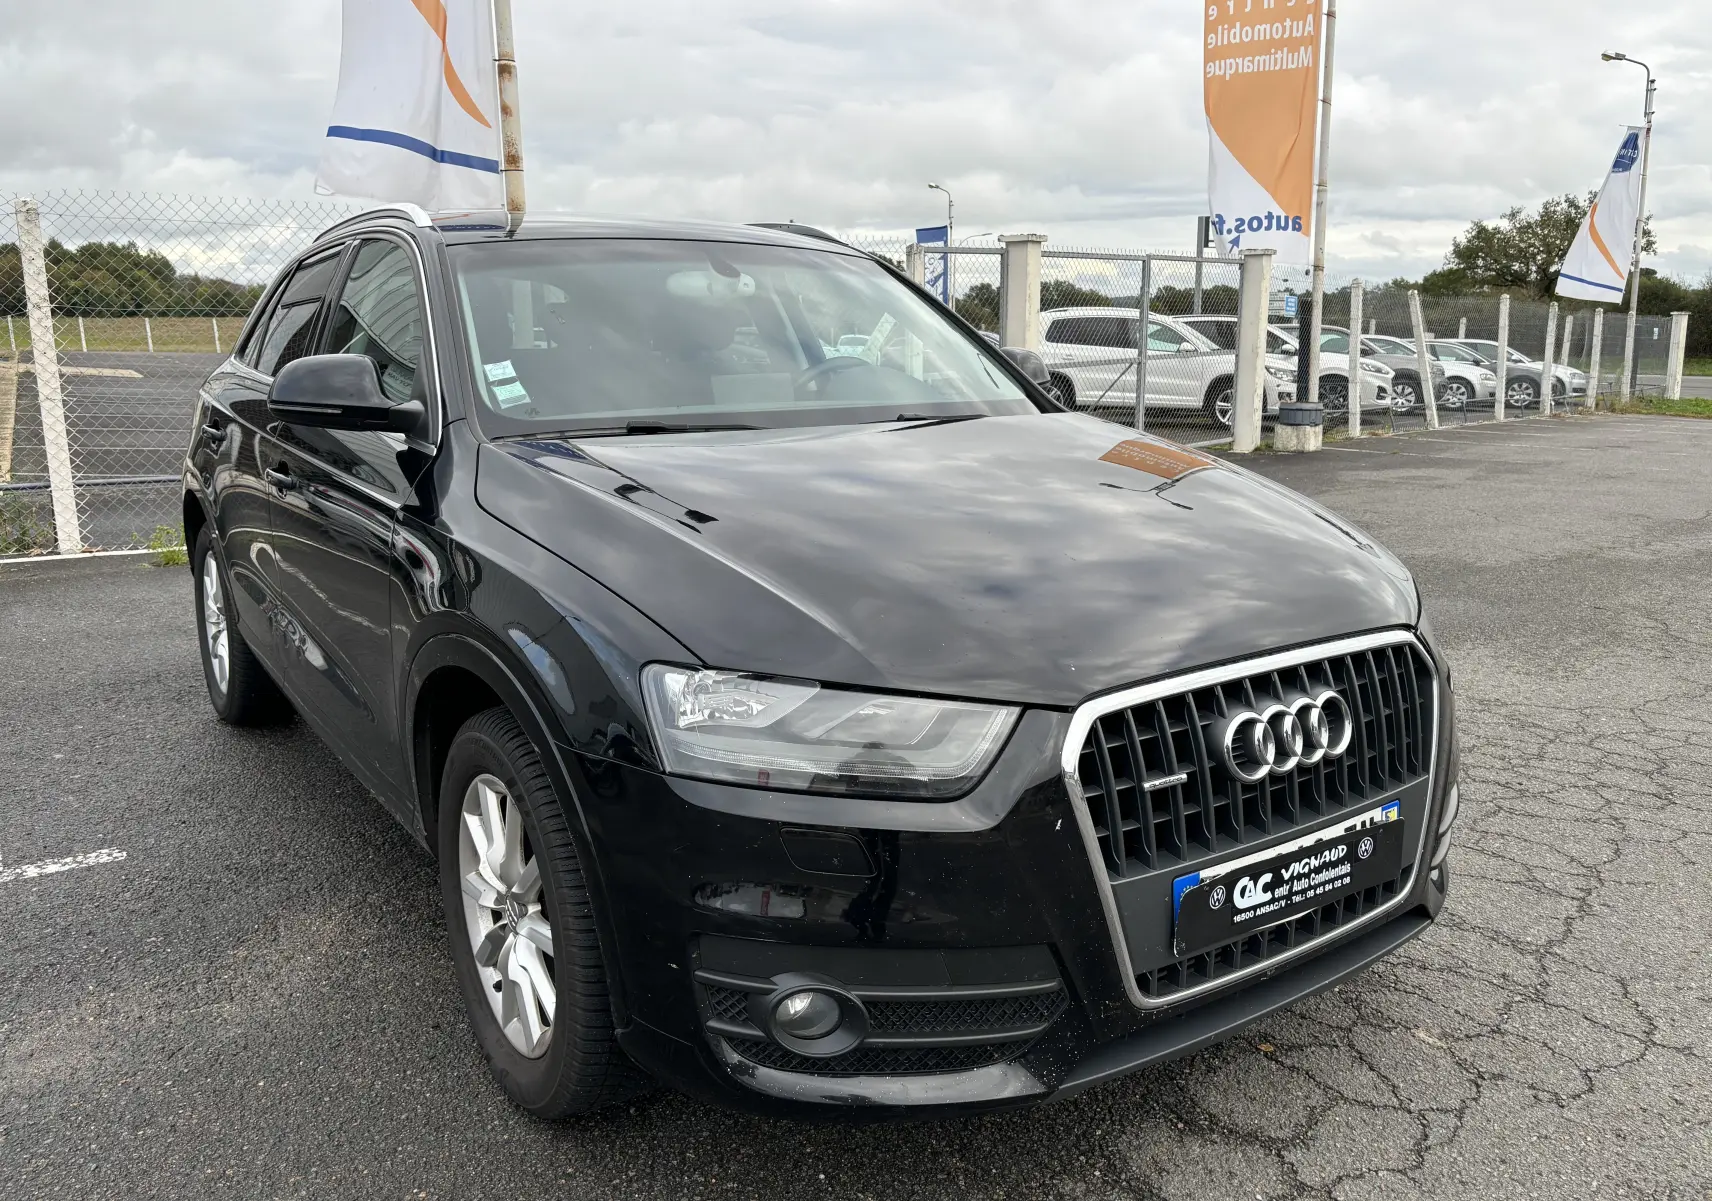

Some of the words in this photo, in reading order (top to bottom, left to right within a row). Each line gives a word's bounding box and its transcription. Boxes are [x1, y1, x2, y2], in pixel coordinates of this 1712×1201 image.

[1281, 844, 1348, 880] VIGNAUD
[1292, 879, 1309, 893] Auto
[1310, 861, 1351, 887] Confolentais
[1233, 872, 1273, 909] CAC
[1233, 911, 1255, 923] 16500
[1255, 899, 1286, 917] ANSAC/V
[1306, 889, 1315, 898] 05
[1315, 885, 1324, 894] 45
[1324, 882, 1333, 891] 84
[1333, 879, 1342, 888] 02
[1342, 876, 1351, 884] 08
